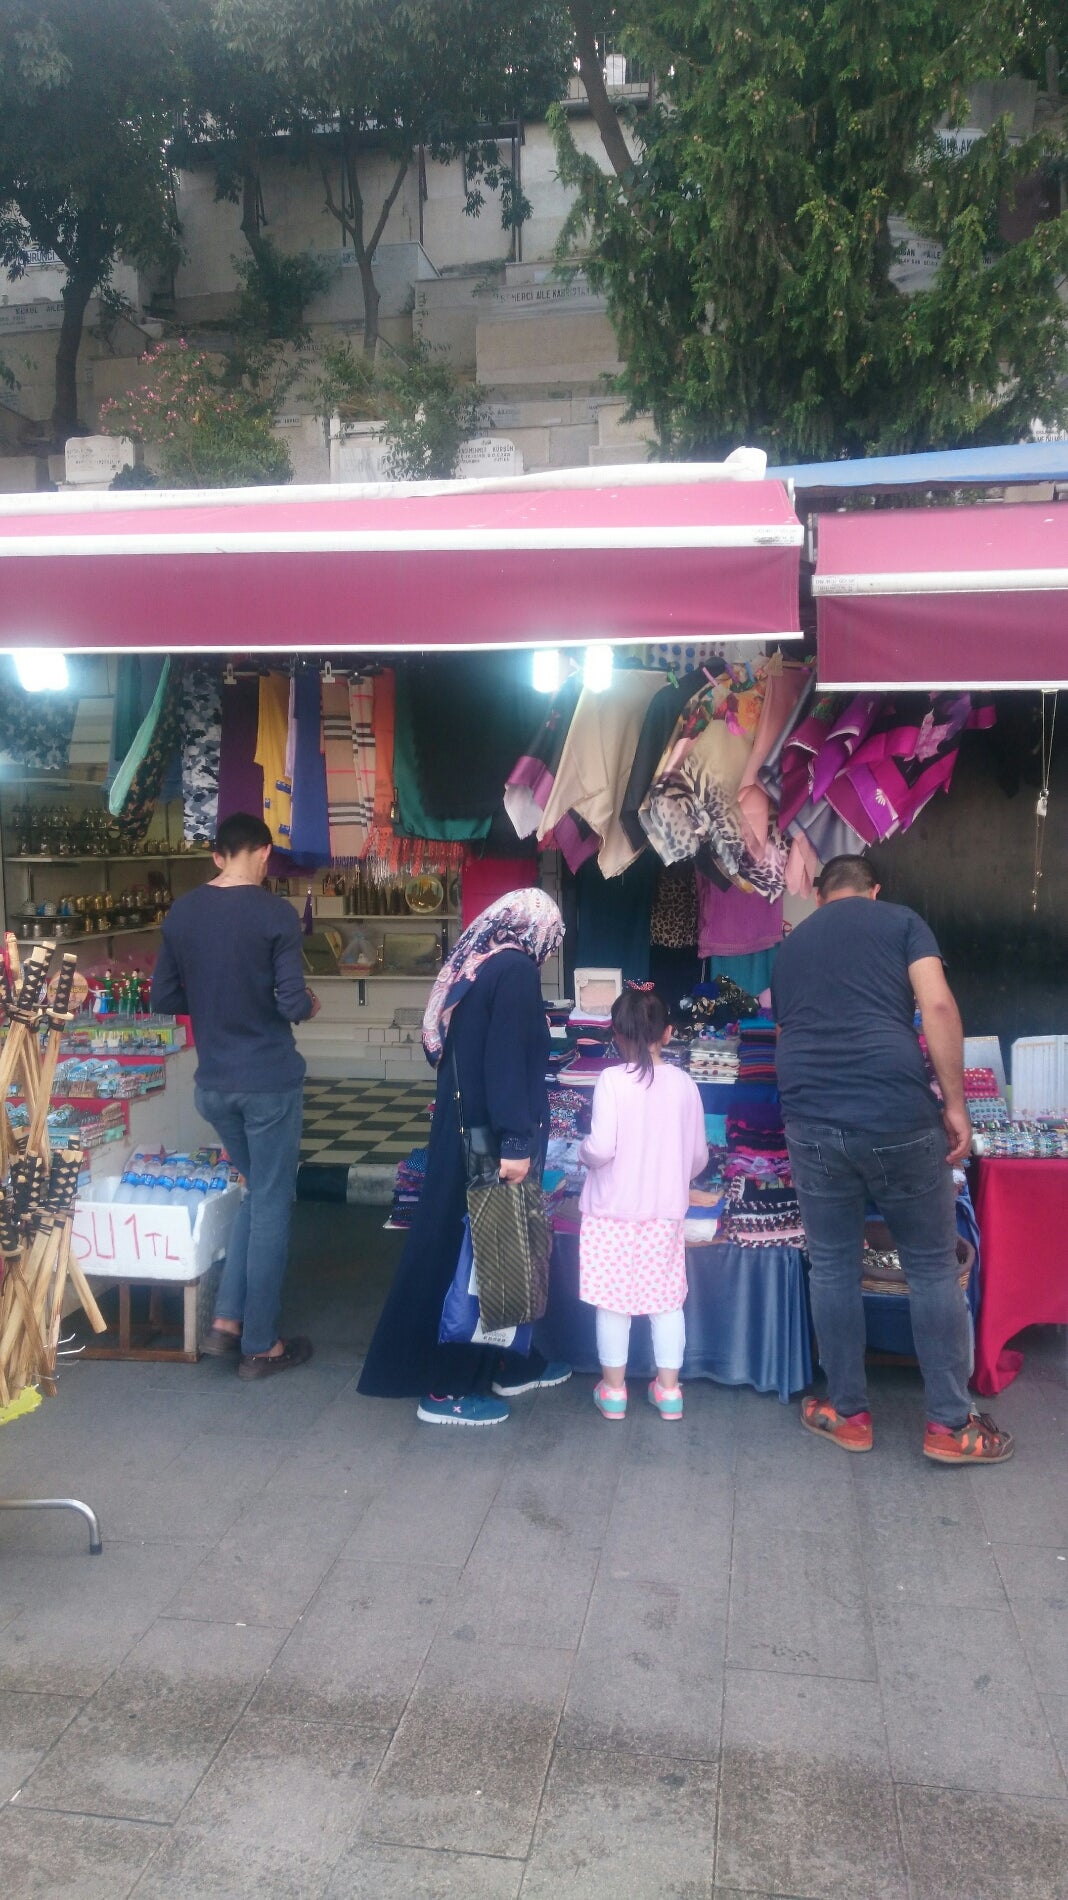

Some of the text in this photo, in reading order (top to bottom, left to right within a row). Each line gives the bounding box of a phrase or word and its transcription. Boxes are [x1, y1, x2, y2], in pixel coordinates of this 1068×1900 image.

[72, 1210, 181, 1261] SU 1 TL
